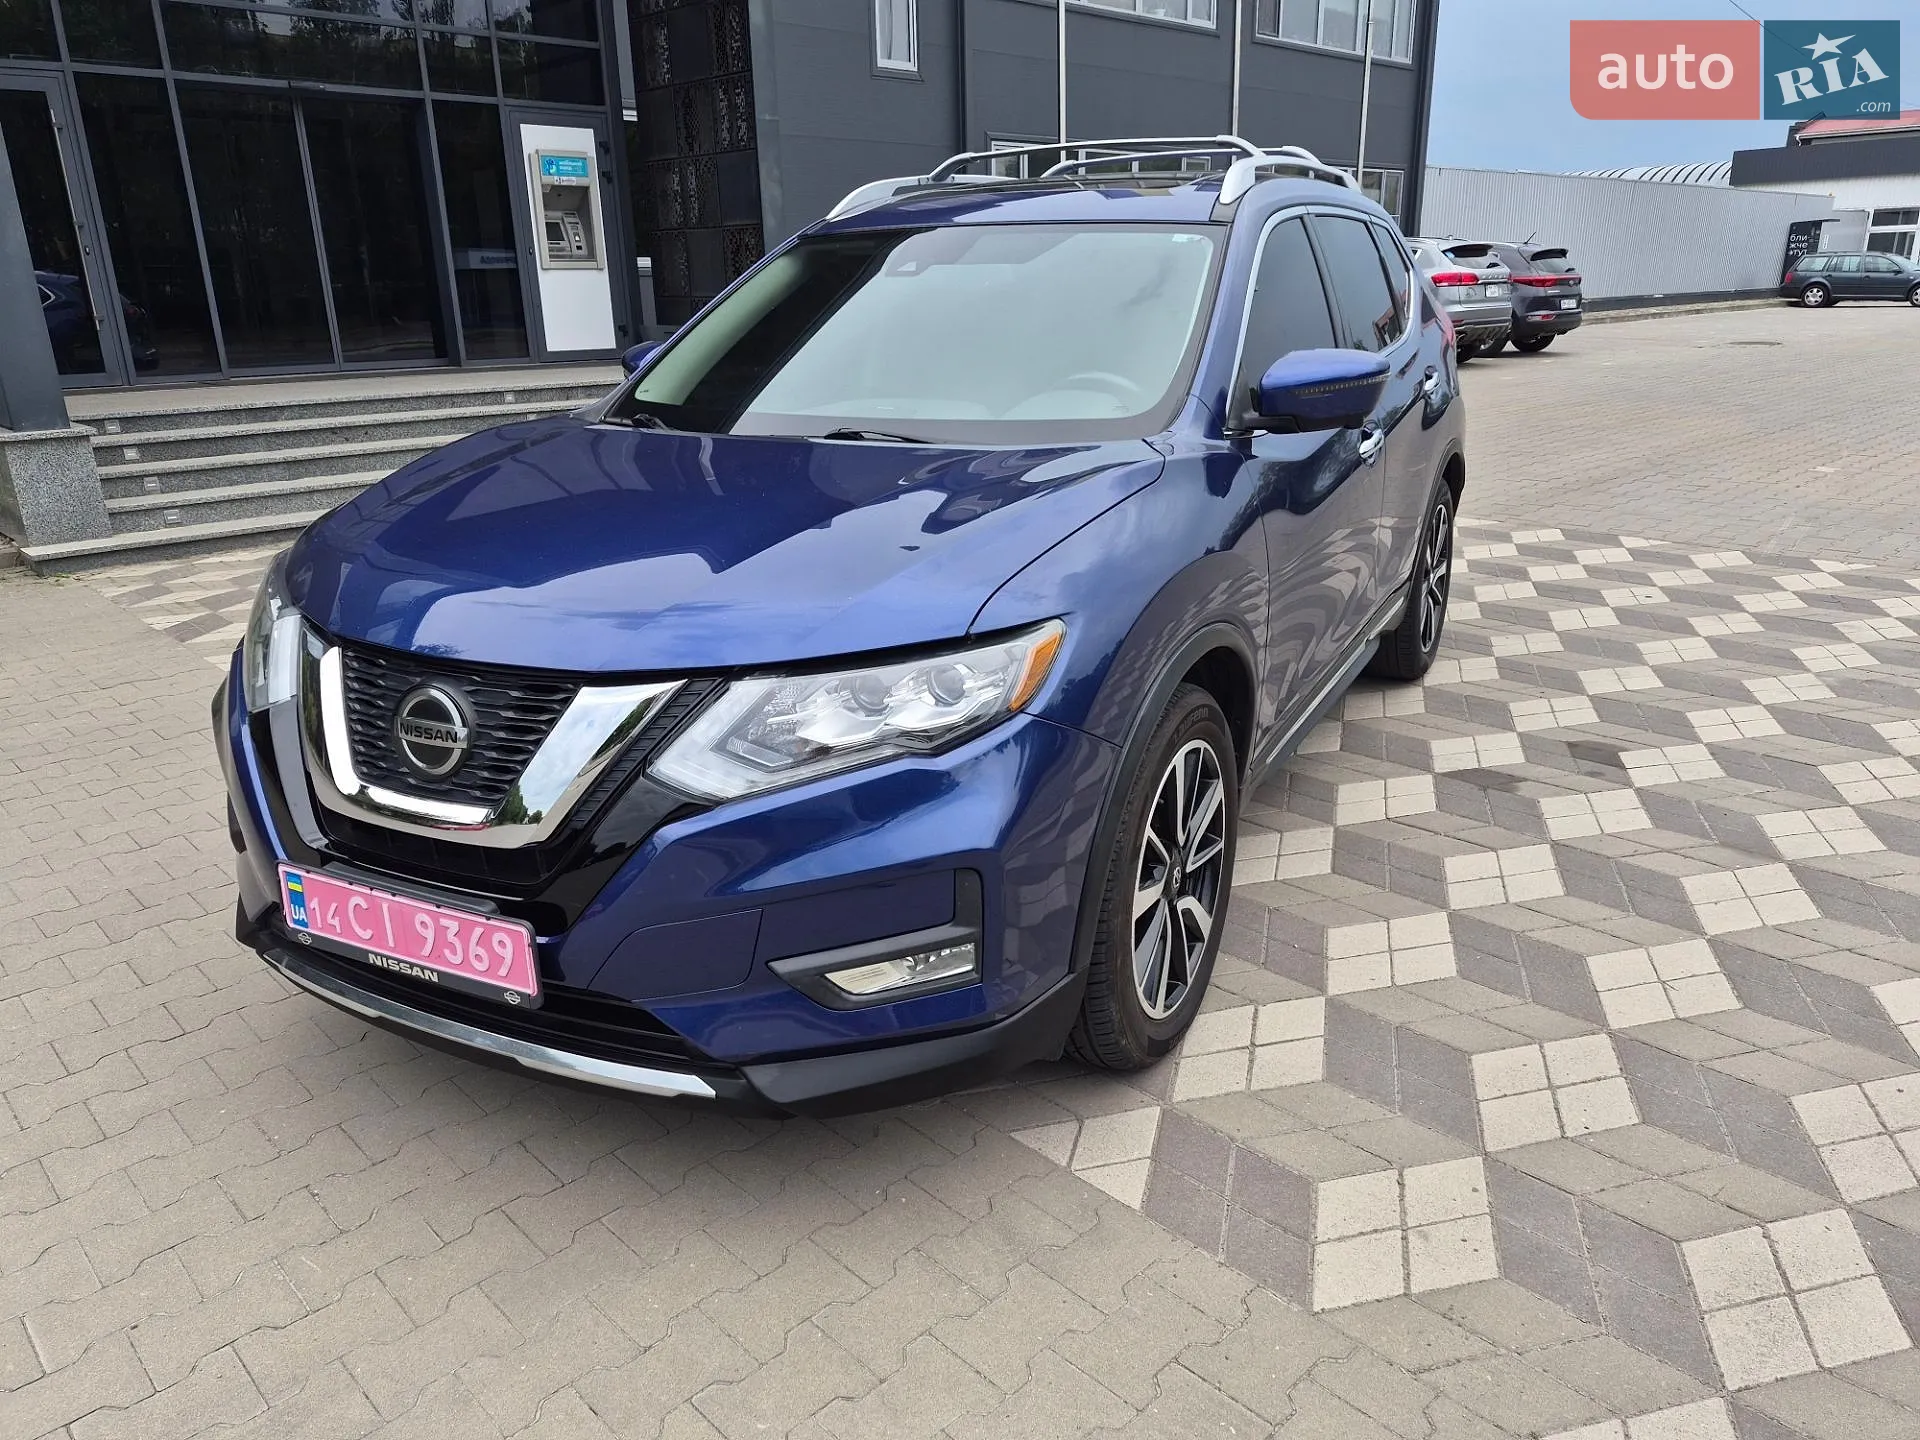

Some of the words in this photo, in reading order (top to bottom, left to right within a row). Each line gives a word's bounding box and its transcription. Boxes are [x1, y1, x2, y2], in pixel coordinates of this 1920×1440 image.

[399, 722, 458, 744] NISSAN
[290, 903, 308, 923] UA
[414, 913, 514, 977] 9369
[368, 953, 439, 983] NISSAN
